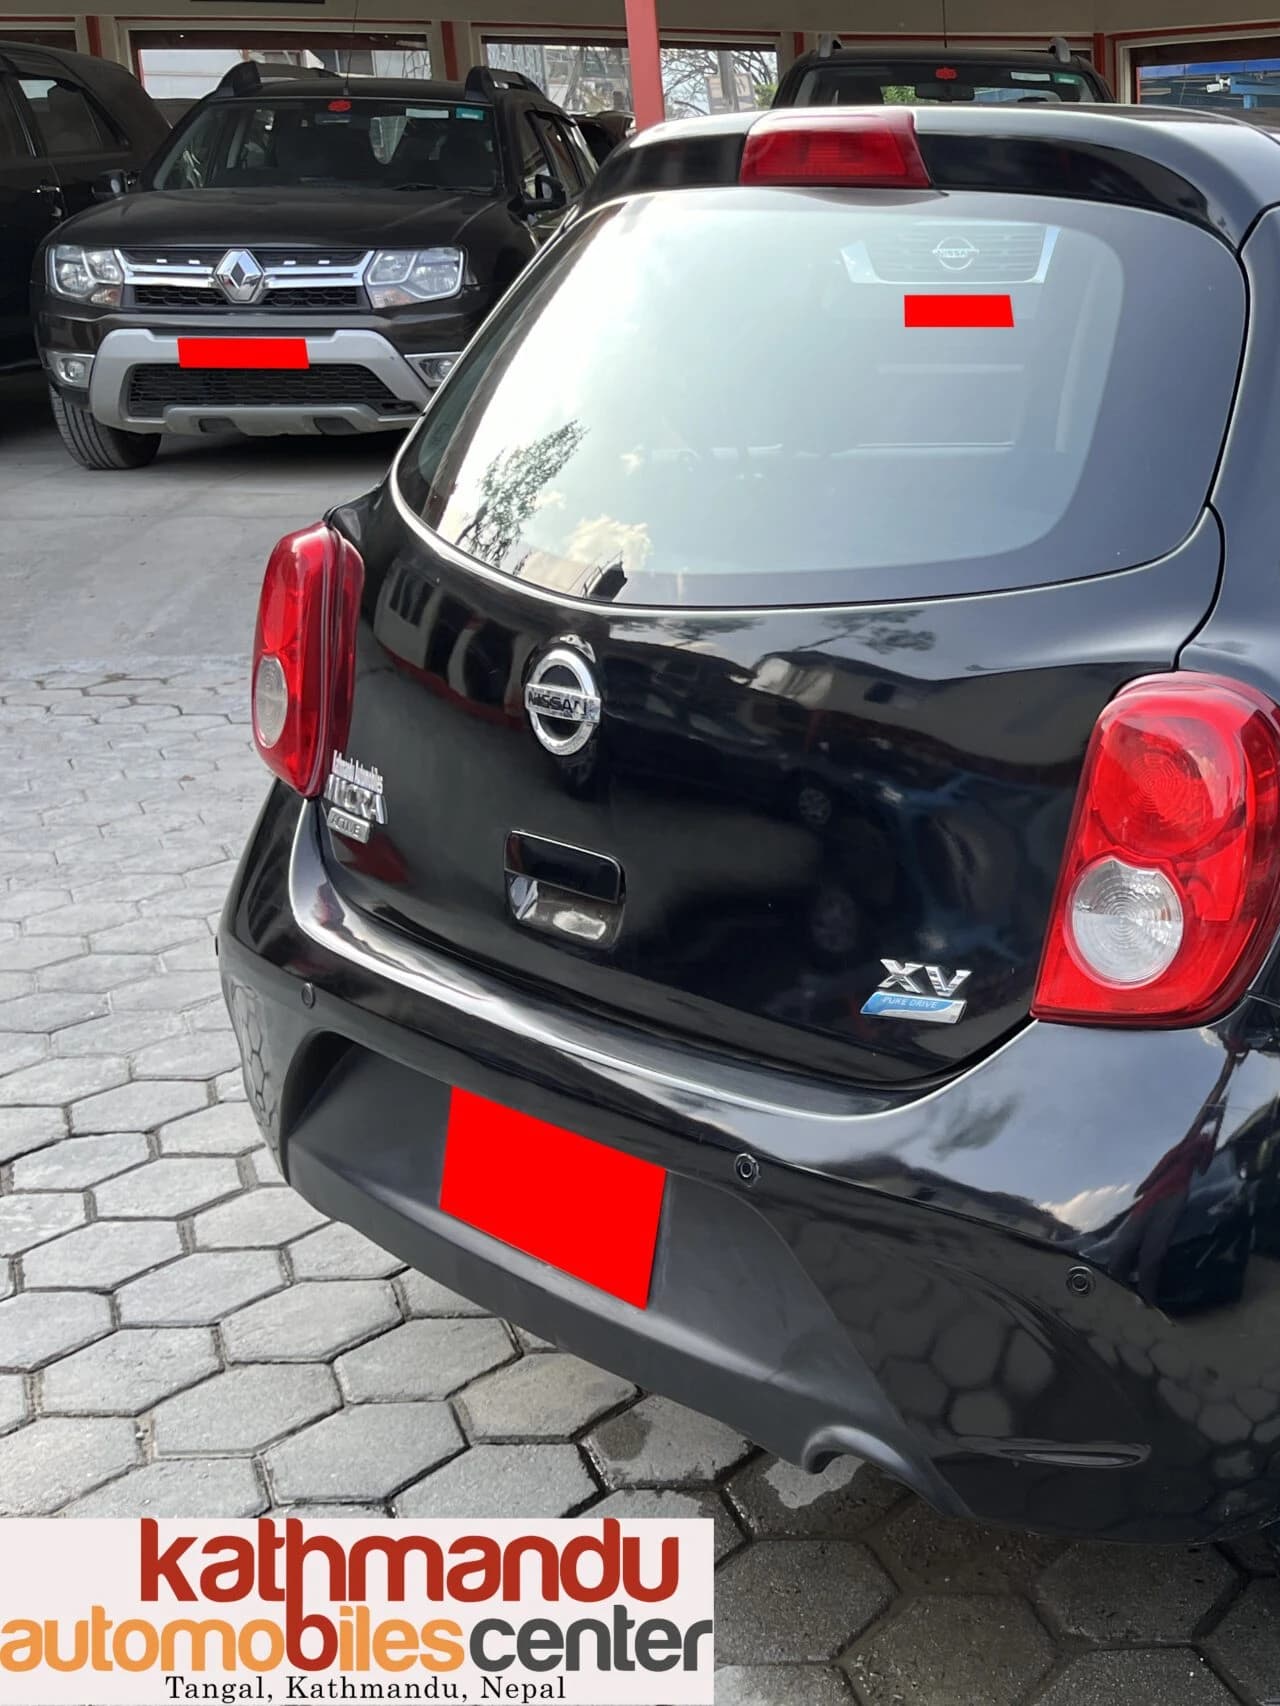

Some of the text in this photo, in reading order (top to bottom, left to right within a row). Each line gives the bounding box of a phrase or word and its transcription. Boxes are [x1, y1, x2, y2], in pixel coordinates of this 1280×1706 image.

[527, 688, 588, 717] NISSAN
[877, 958, 973, 997] XV
[908, 999, 938, 1009] DRIVE
